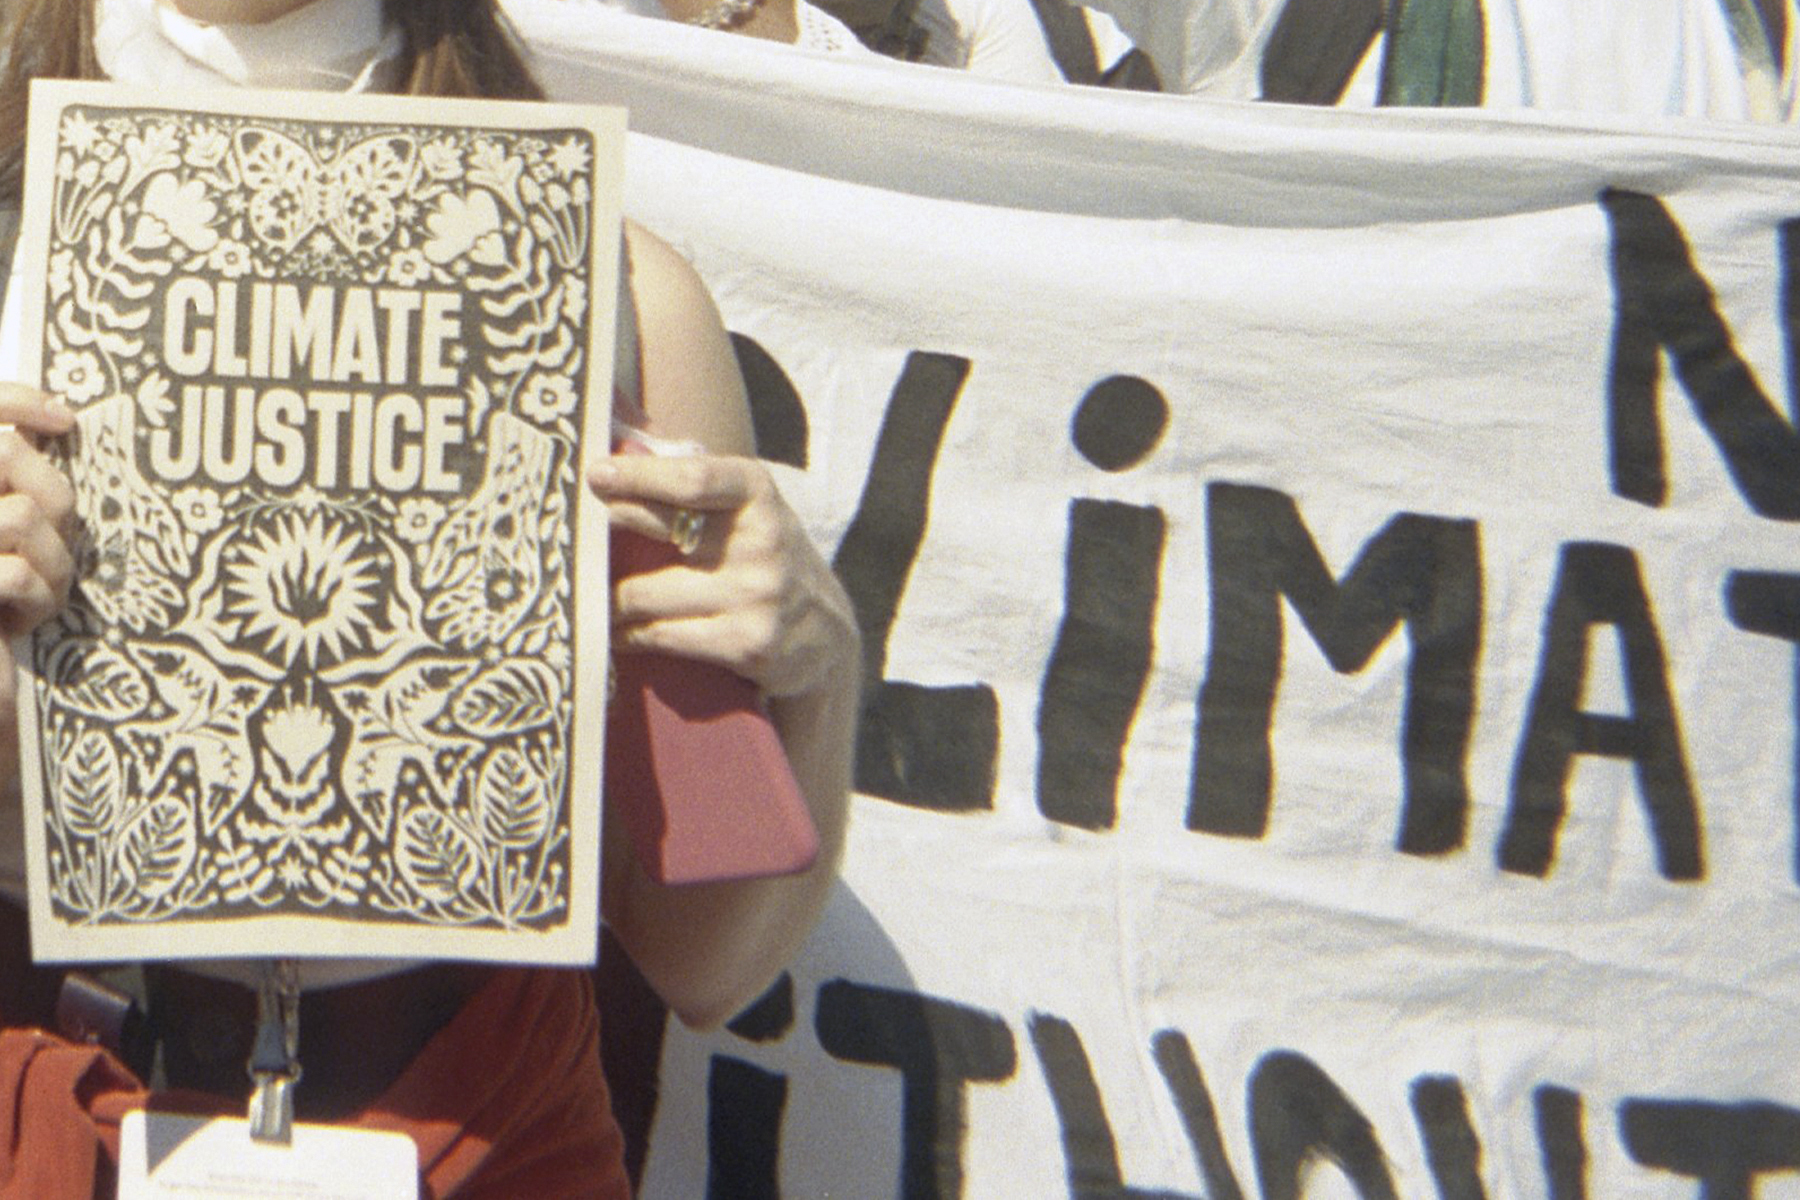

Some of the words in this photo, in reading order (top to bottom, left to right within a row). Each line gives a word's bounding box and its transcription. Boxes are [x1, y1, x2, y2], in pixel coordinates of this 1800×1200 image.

[163, 276, 463, 387] CLIMATE
[150, 384, 465, 493] JUSTICE
[727, 330, 1800, 883] LiMA
